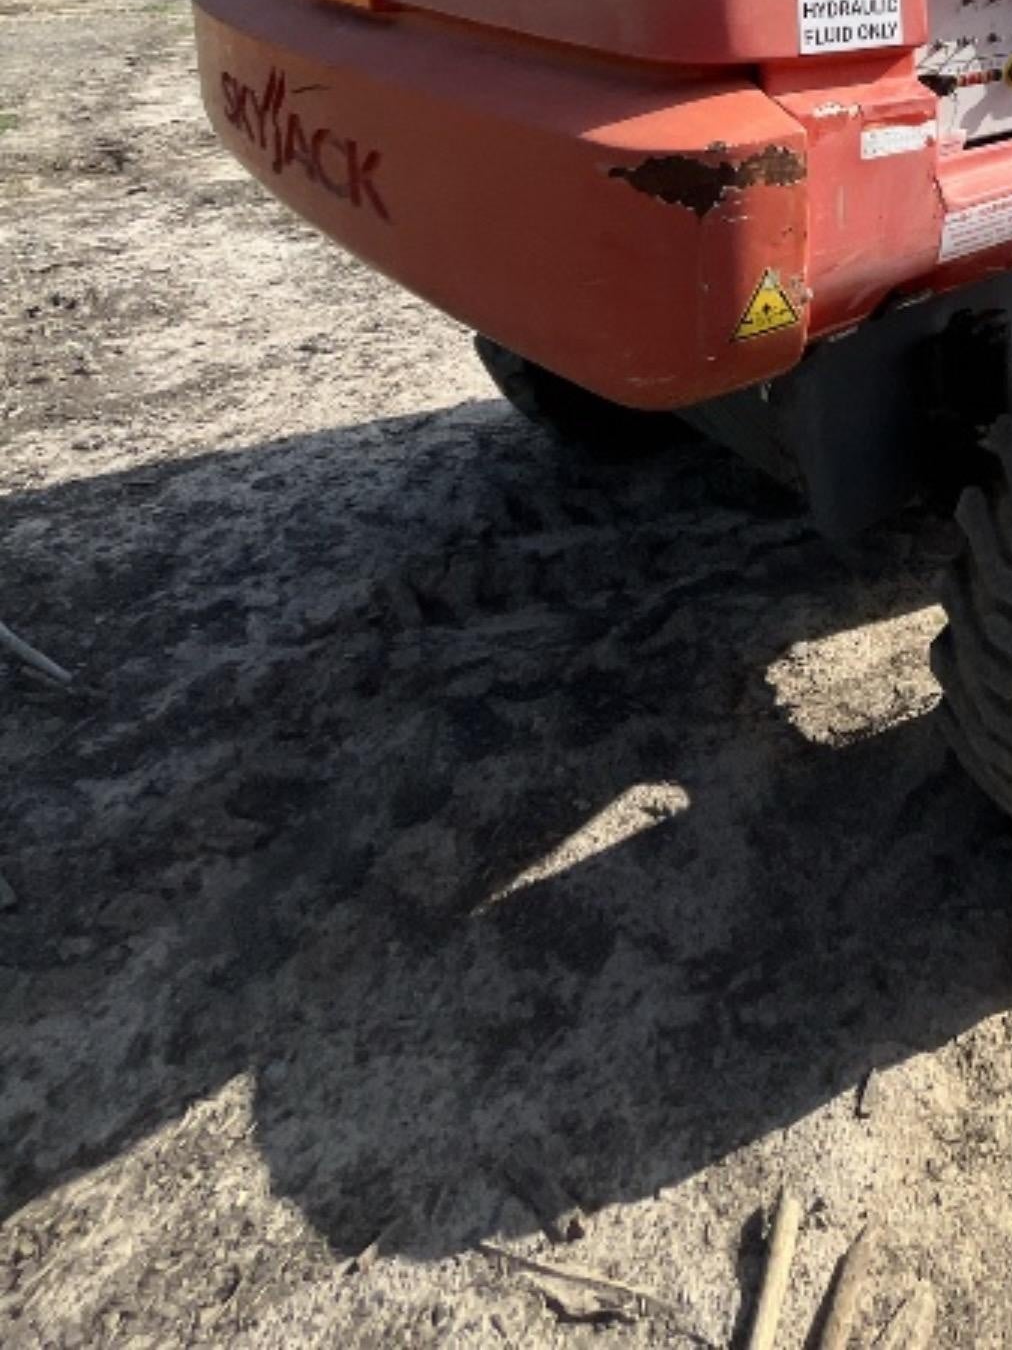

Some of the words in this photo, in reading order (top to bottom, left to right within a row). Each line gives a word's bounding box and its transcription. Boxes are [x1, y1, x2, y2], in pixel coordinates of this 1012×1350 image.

[804, 26, 852, 45] FLUID
[858, 20, 897, 39] ONLY
[221, 66, 392, 224] SKYJACK
